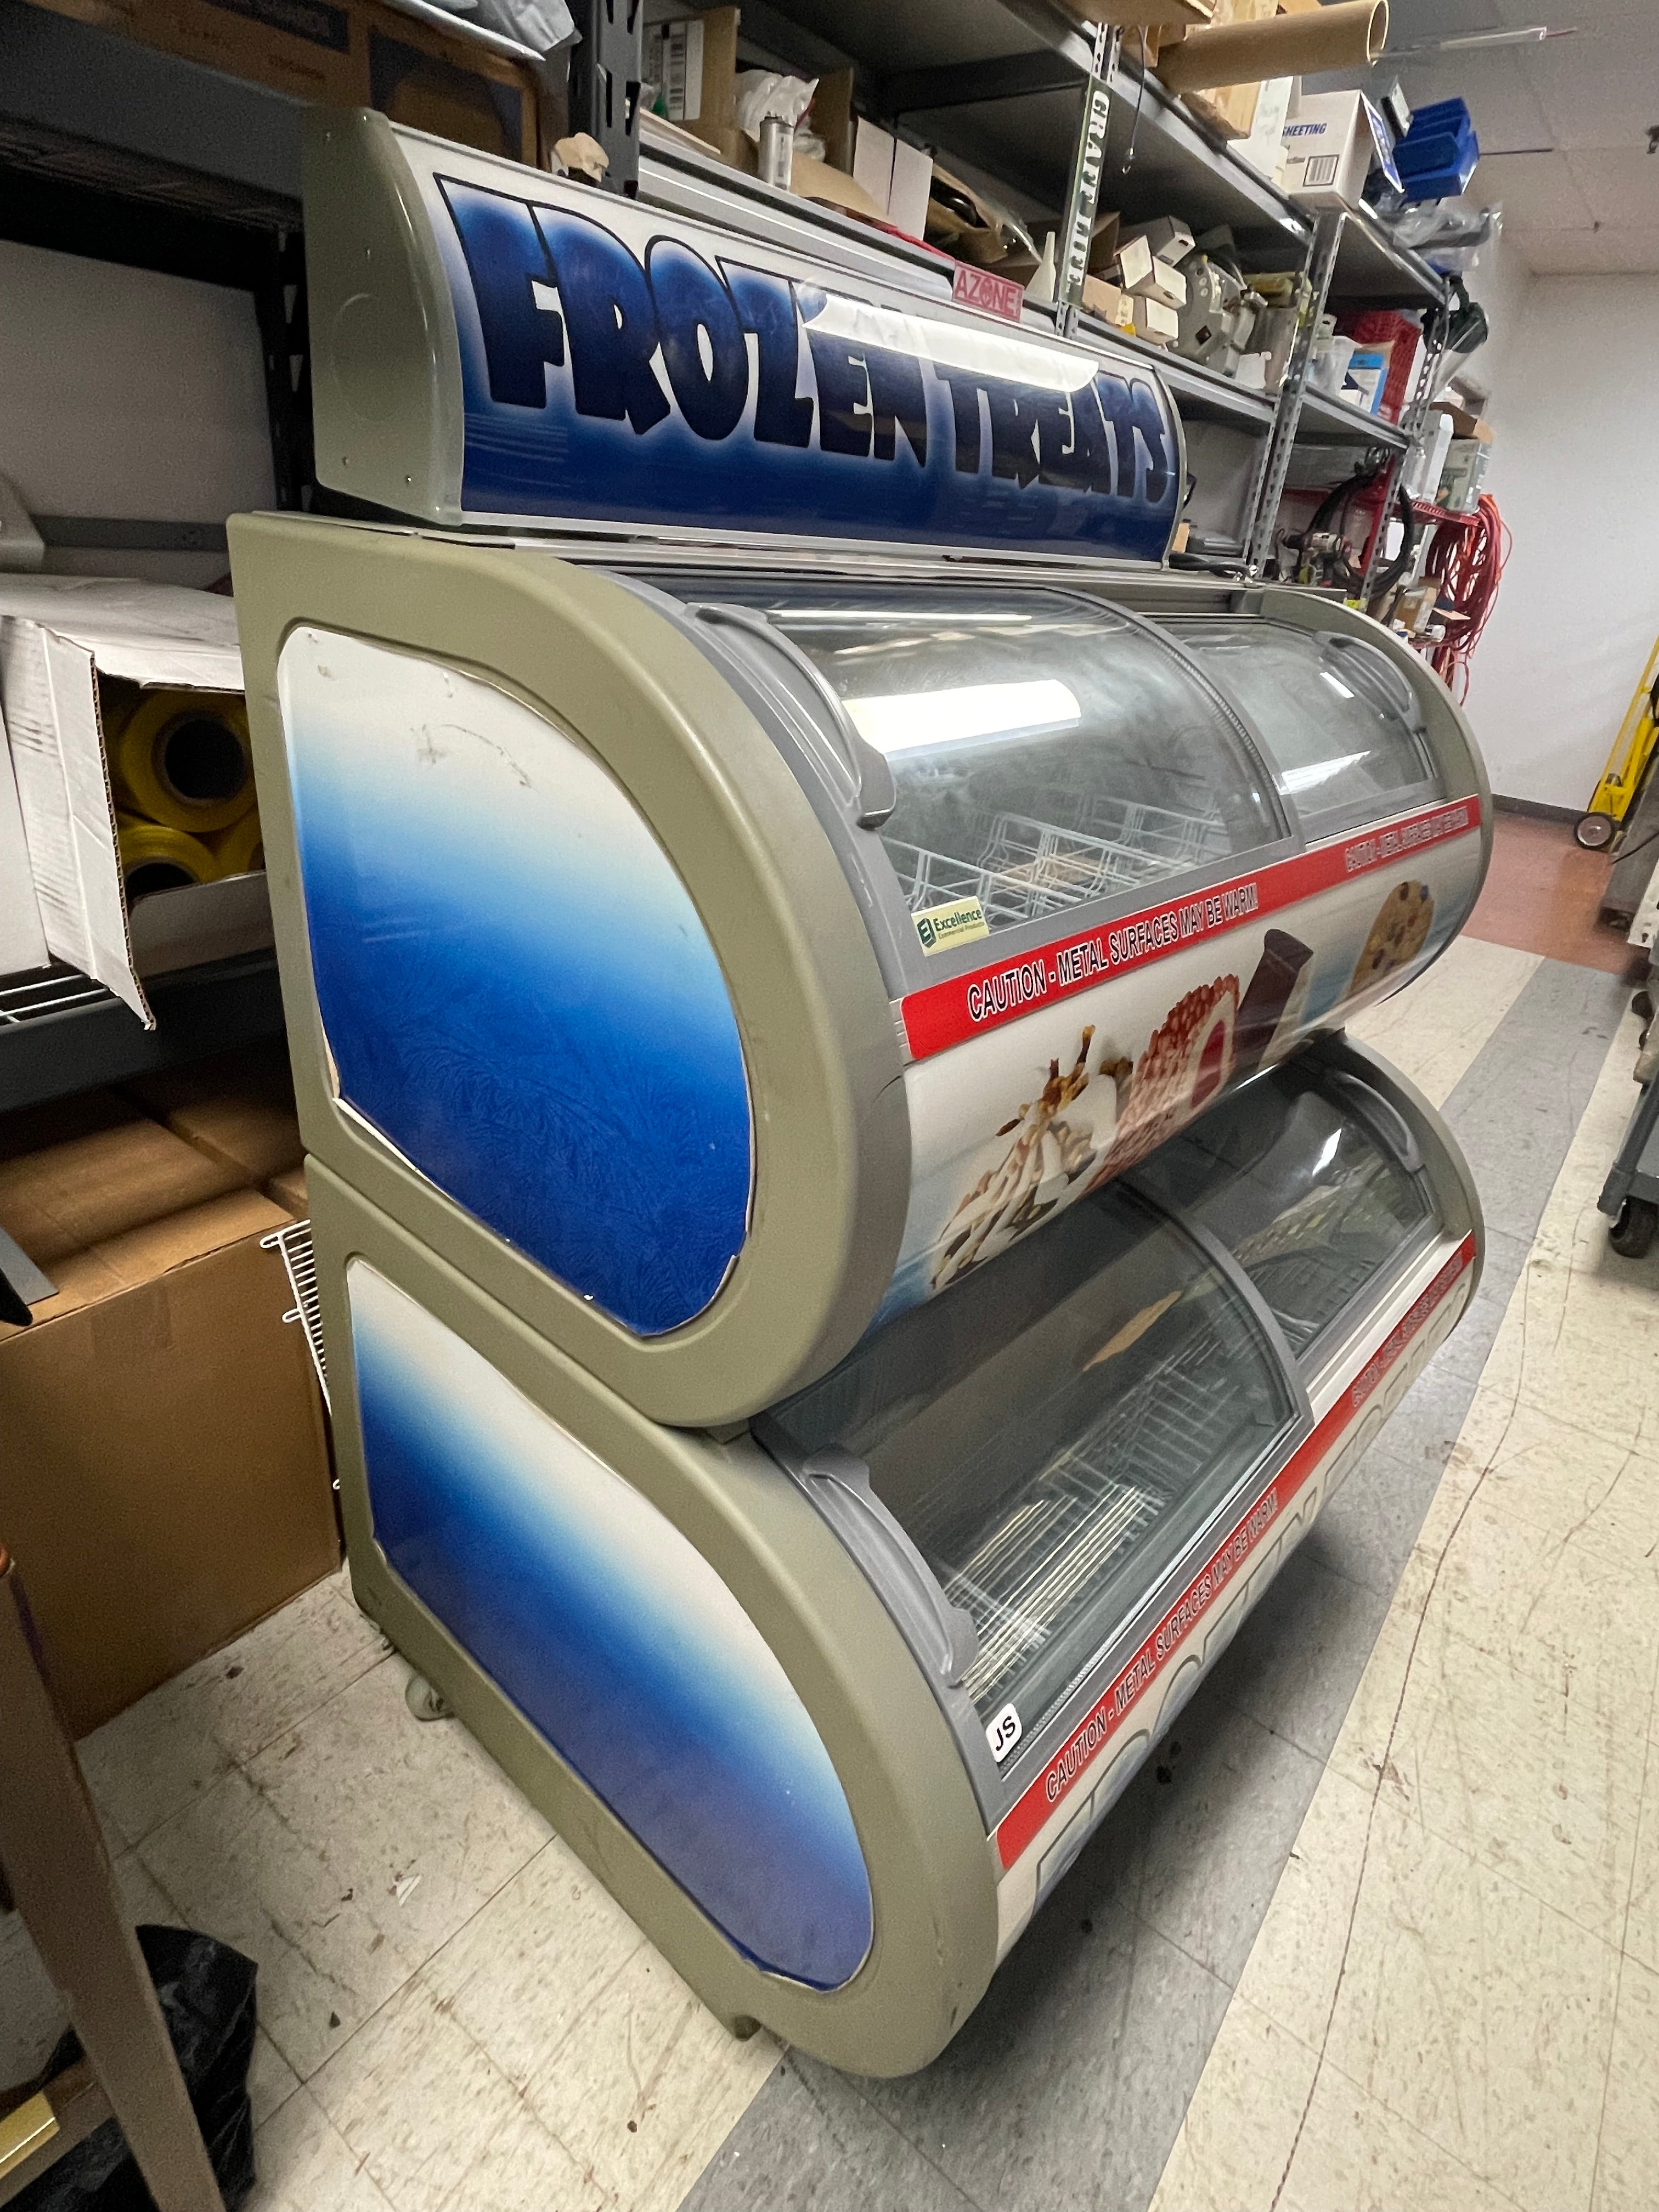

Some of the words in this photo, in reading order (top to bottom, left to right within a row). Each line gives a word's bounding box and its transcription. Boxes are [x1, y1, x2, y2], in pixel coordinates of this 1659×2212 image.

[432, 172, 928, 468] FROZEN
[930, 318, 1169, 504] TREATS
[933, 909, 983, 932] Excellence
[967, 958, 1047, 1022] CAUTION
[1056, 938, 1109, 987] METAL
[1108, 911, 1179, 966] SURFACES
[1177, 900, 1205, 938] MAY
[1206, 895, 1223, 929] BE
[1045, 1706, 1107, 1803] CAUTION
[1114, 1650, 1156, 1717] METAL
[1155, 1573, 1213, 1661] SURFACES
[1211, 1542, 1234, 1588] MAY
[1233, 1528, 1249, 1561] BE
[996, 1716, 1015, 1751] JS
